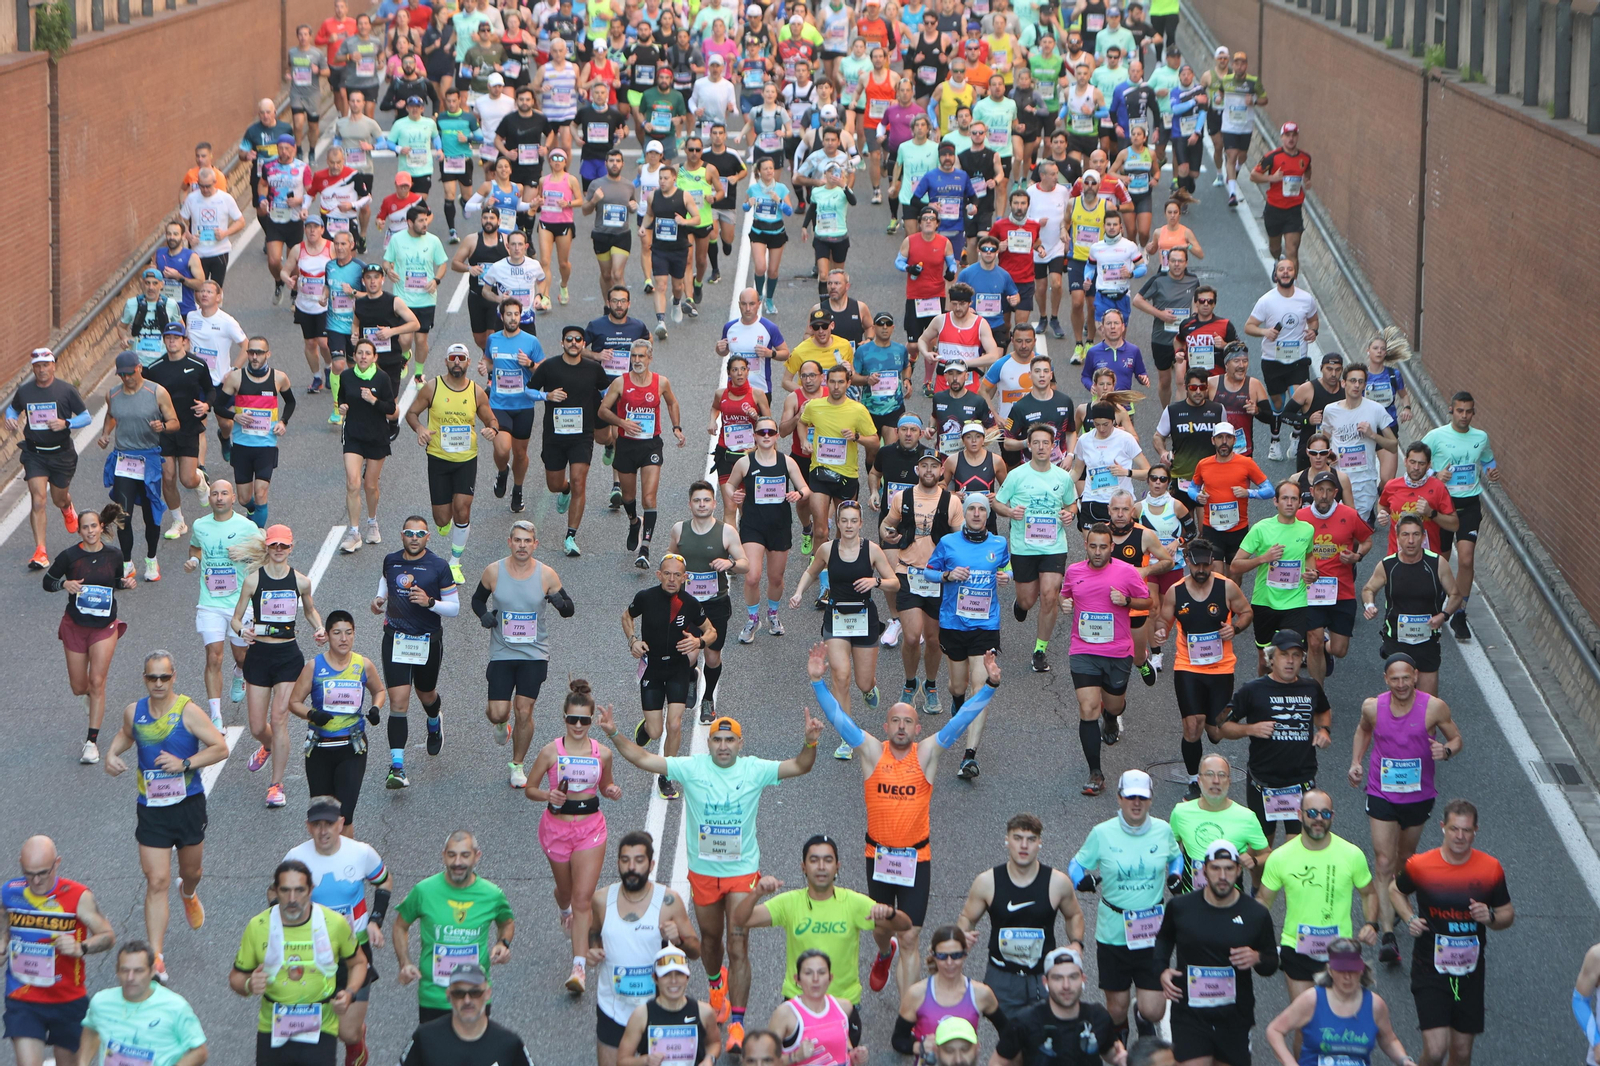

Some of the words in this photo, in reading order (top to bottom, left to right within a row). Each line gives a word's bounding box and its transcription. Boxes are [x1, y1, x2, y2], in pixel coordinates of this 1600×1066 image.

[510, 267, 525, 276] ROB
[1347, 446, 1363, 454] ZURICH
[1315, 533, 1333, 544] 42
[1199, 634, 1218, 642] ZURICH
[337, 680, 359, 689] ZURICH
[337, 692, 350, 700] 7186
[1269, 696, 1284, 704] XXIII
[1285, 694, 1312, 704] TRIATLÓN
[156, 771, 177, 779] ZURICH
[877, 783, 916, 796] IVECO
[1276, 788, 1297, 796] ZURICH
[812, 920, 847, 934] asics
[1312, 927, 1334, 935] ZURICH
[1448, 922, 1478, 933] RUN
[1452, 939, 1473, 947] ZURICH
[23, 945, 50, 954] ZURICH
[449, 947, 474, 956] ZURICH
[628, 965, 654, 975] ZURICH
[1204, 969, 1229, 978] ZURICH
[289, 1005, 318, 1014] ZURICH
[666, 1029, 692, 1037] ZURICH
[123, 1047, 150, 1059] ZURICH
